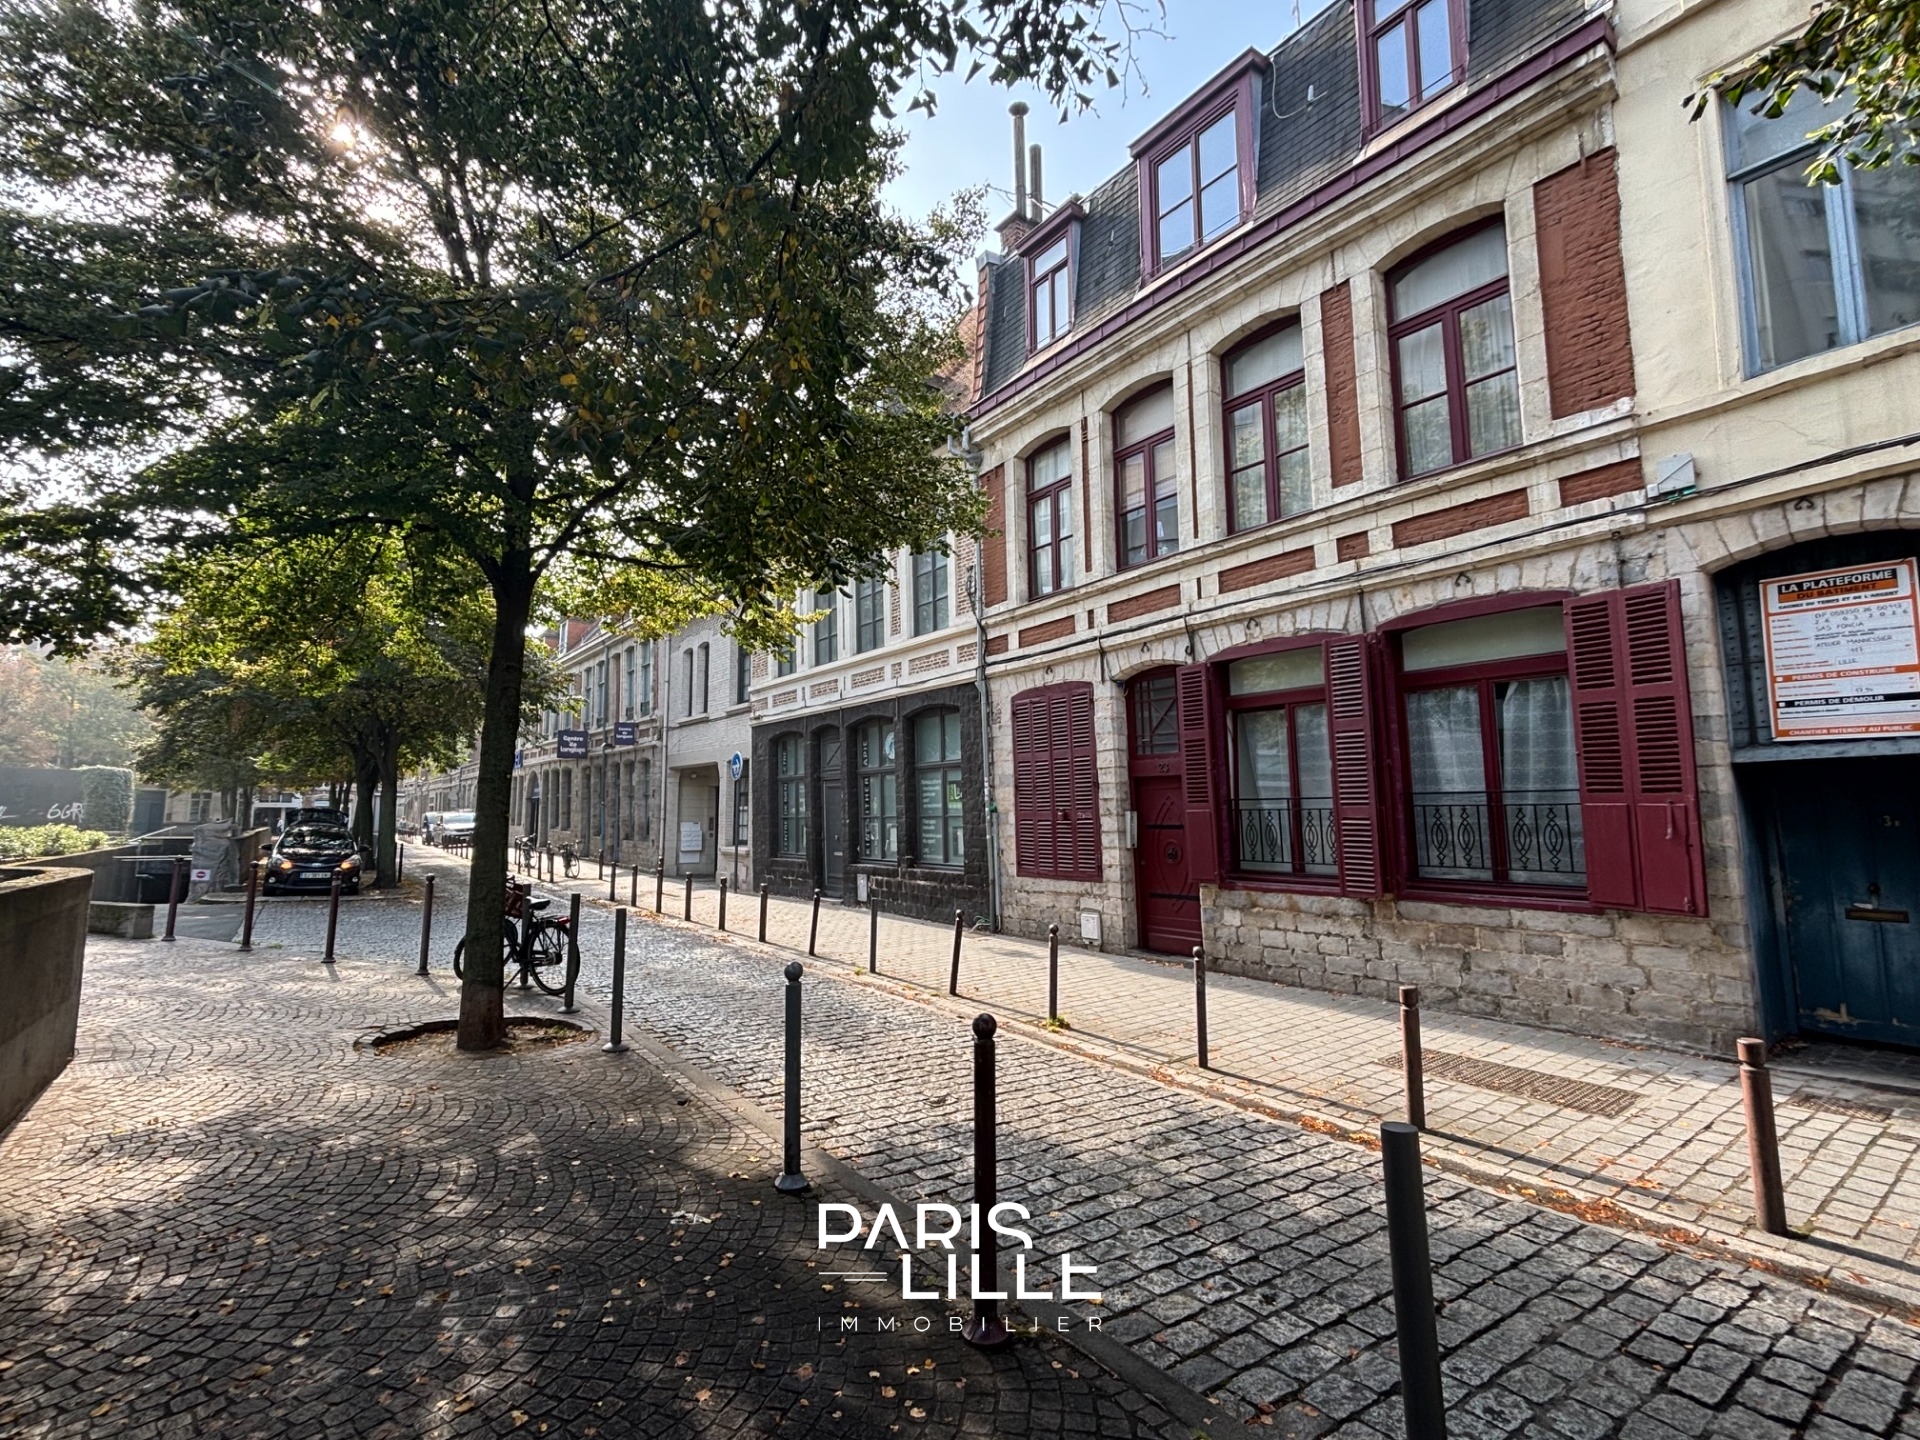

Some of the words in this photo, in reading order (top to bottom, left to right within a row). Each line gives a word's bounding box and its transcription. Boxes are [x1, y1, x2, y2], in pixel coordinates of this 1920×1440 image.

[1782, 584, 1798, 594] LA
[1803, 570, 1893, 590] PLATEFORME
[1796, 590, 1814, 599] DU
[1792, 672, 1824, 681] PERMIS
[1794, 698, 1826, 706] PERMIS
